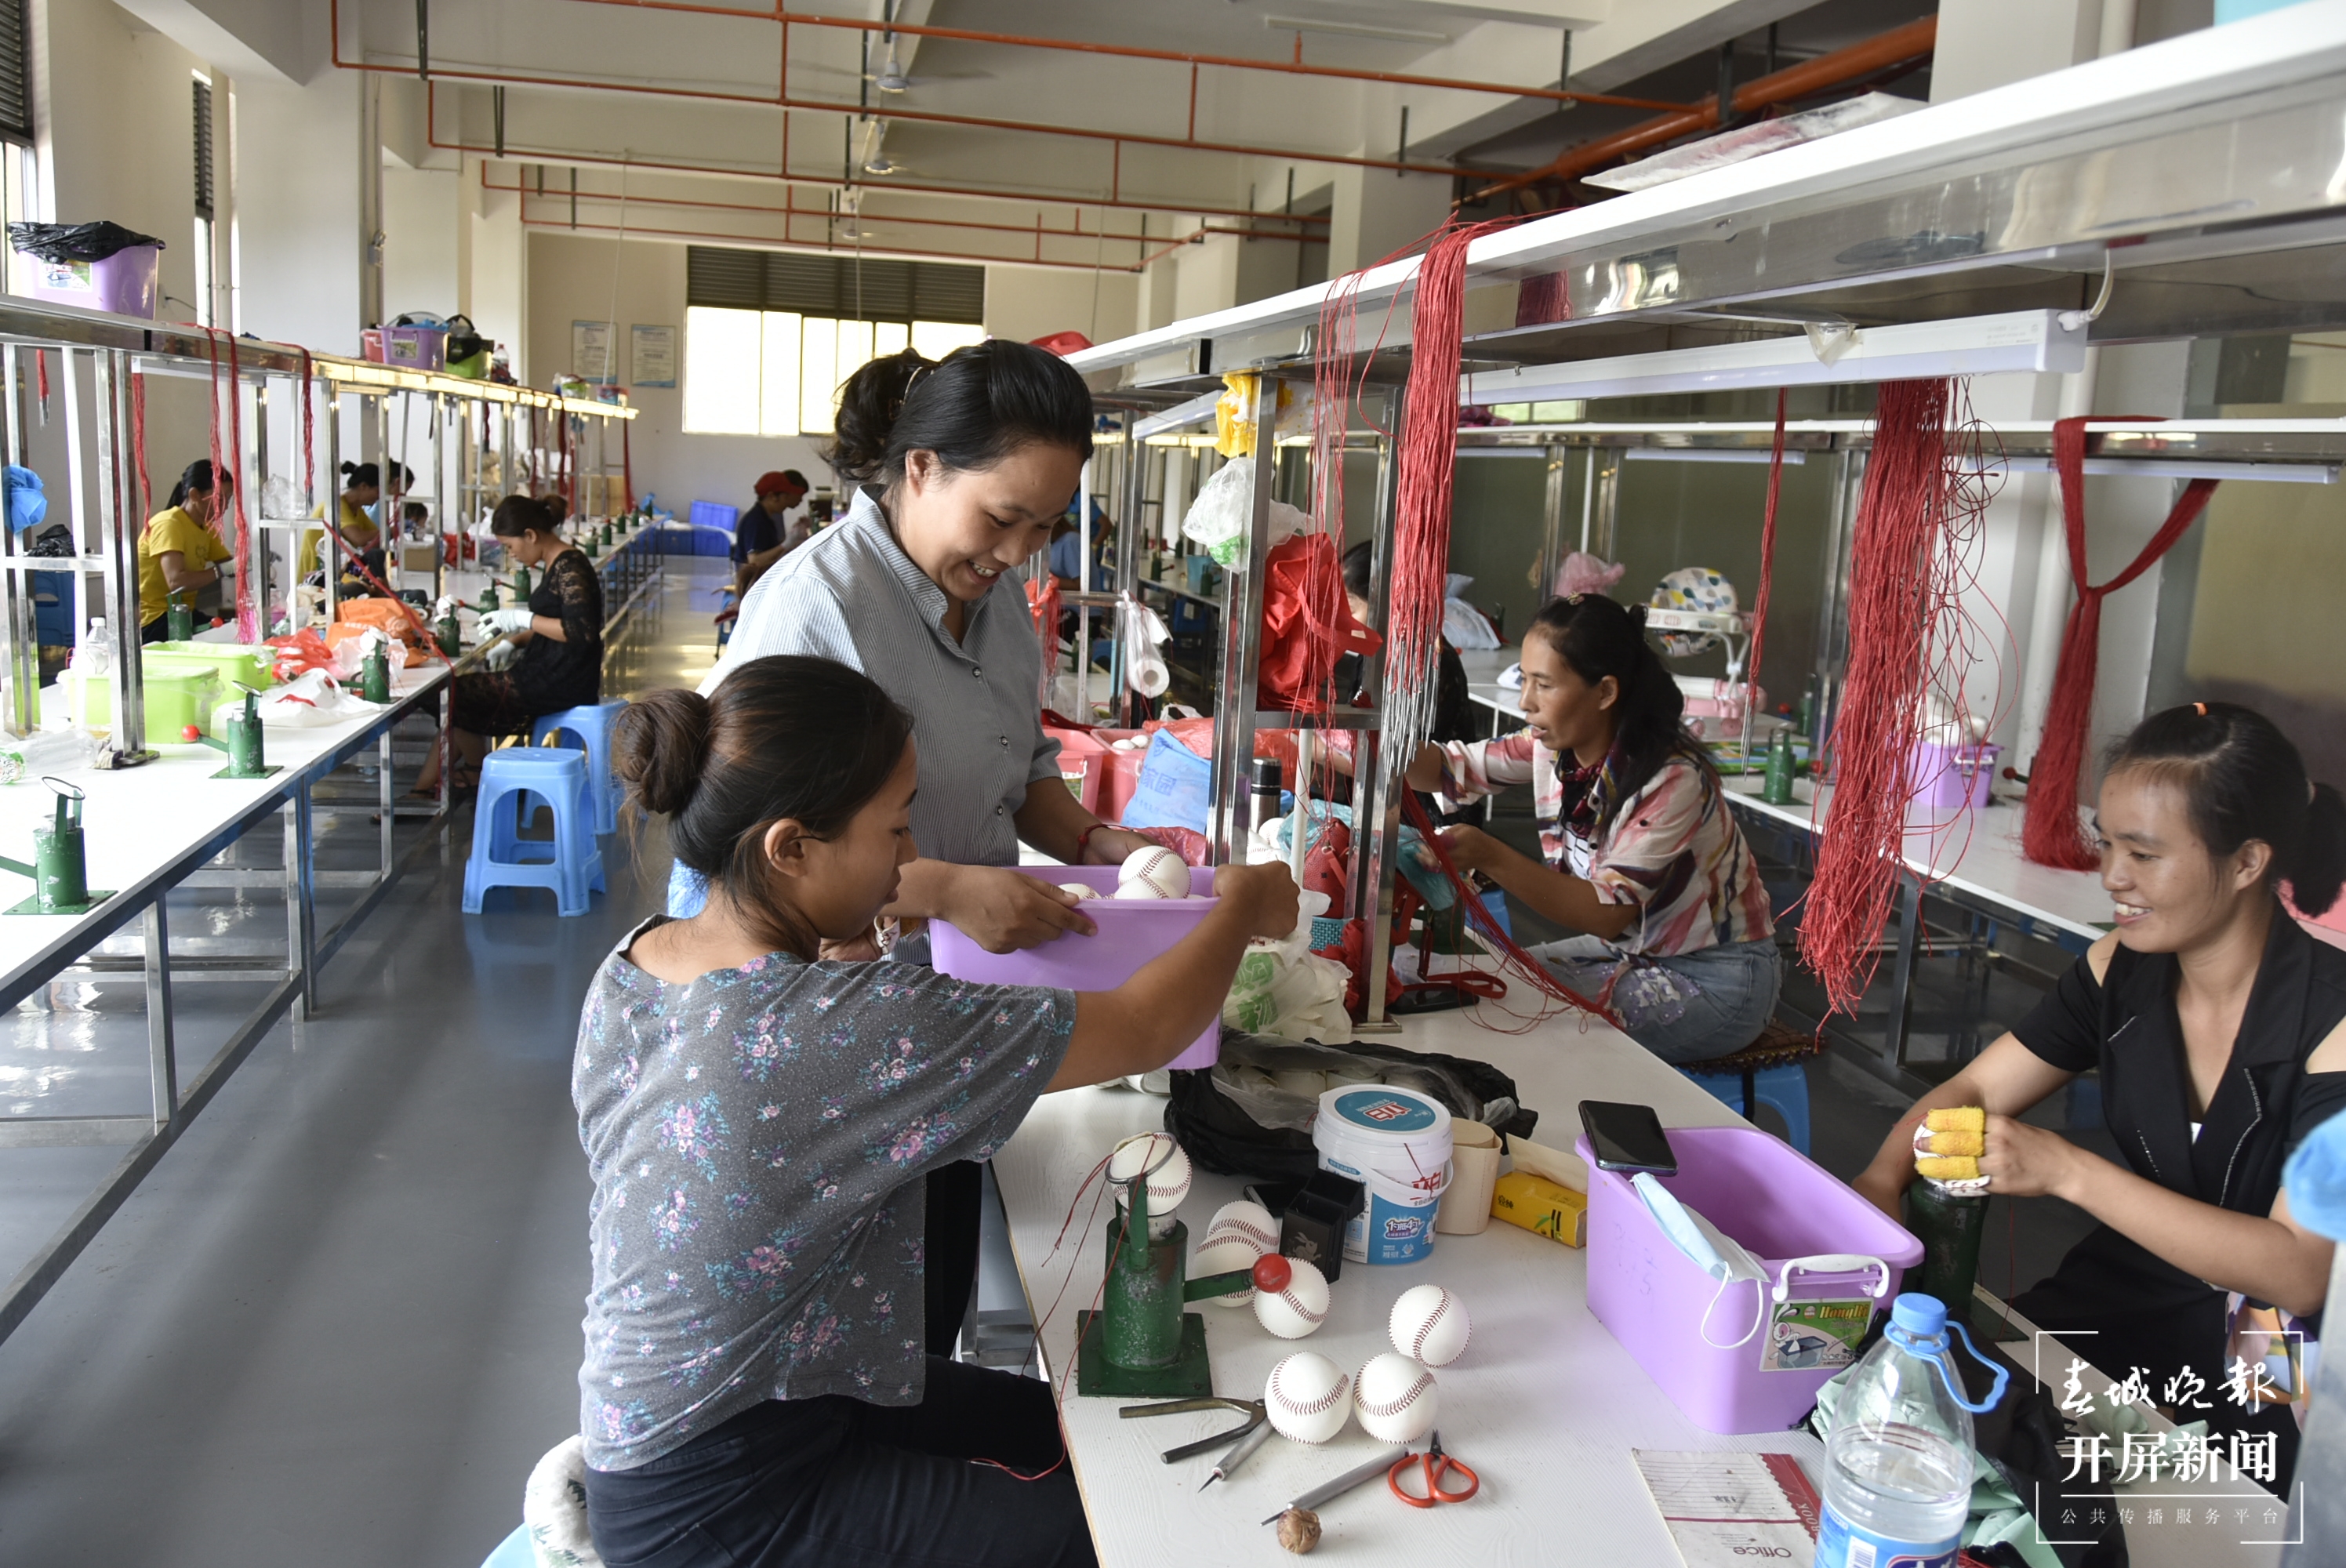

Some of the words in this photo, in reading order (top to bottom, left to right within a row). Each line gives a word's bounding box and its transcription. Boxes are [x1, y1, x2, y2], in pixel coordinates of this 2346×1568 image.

[1142, 767, 1177, 796] 家园
[1819, 1304, 1870, 1319] HongRi
[1796, 1502, 1820, 1535] BOOK
[1733, 1547, 1792, 1559] Office
